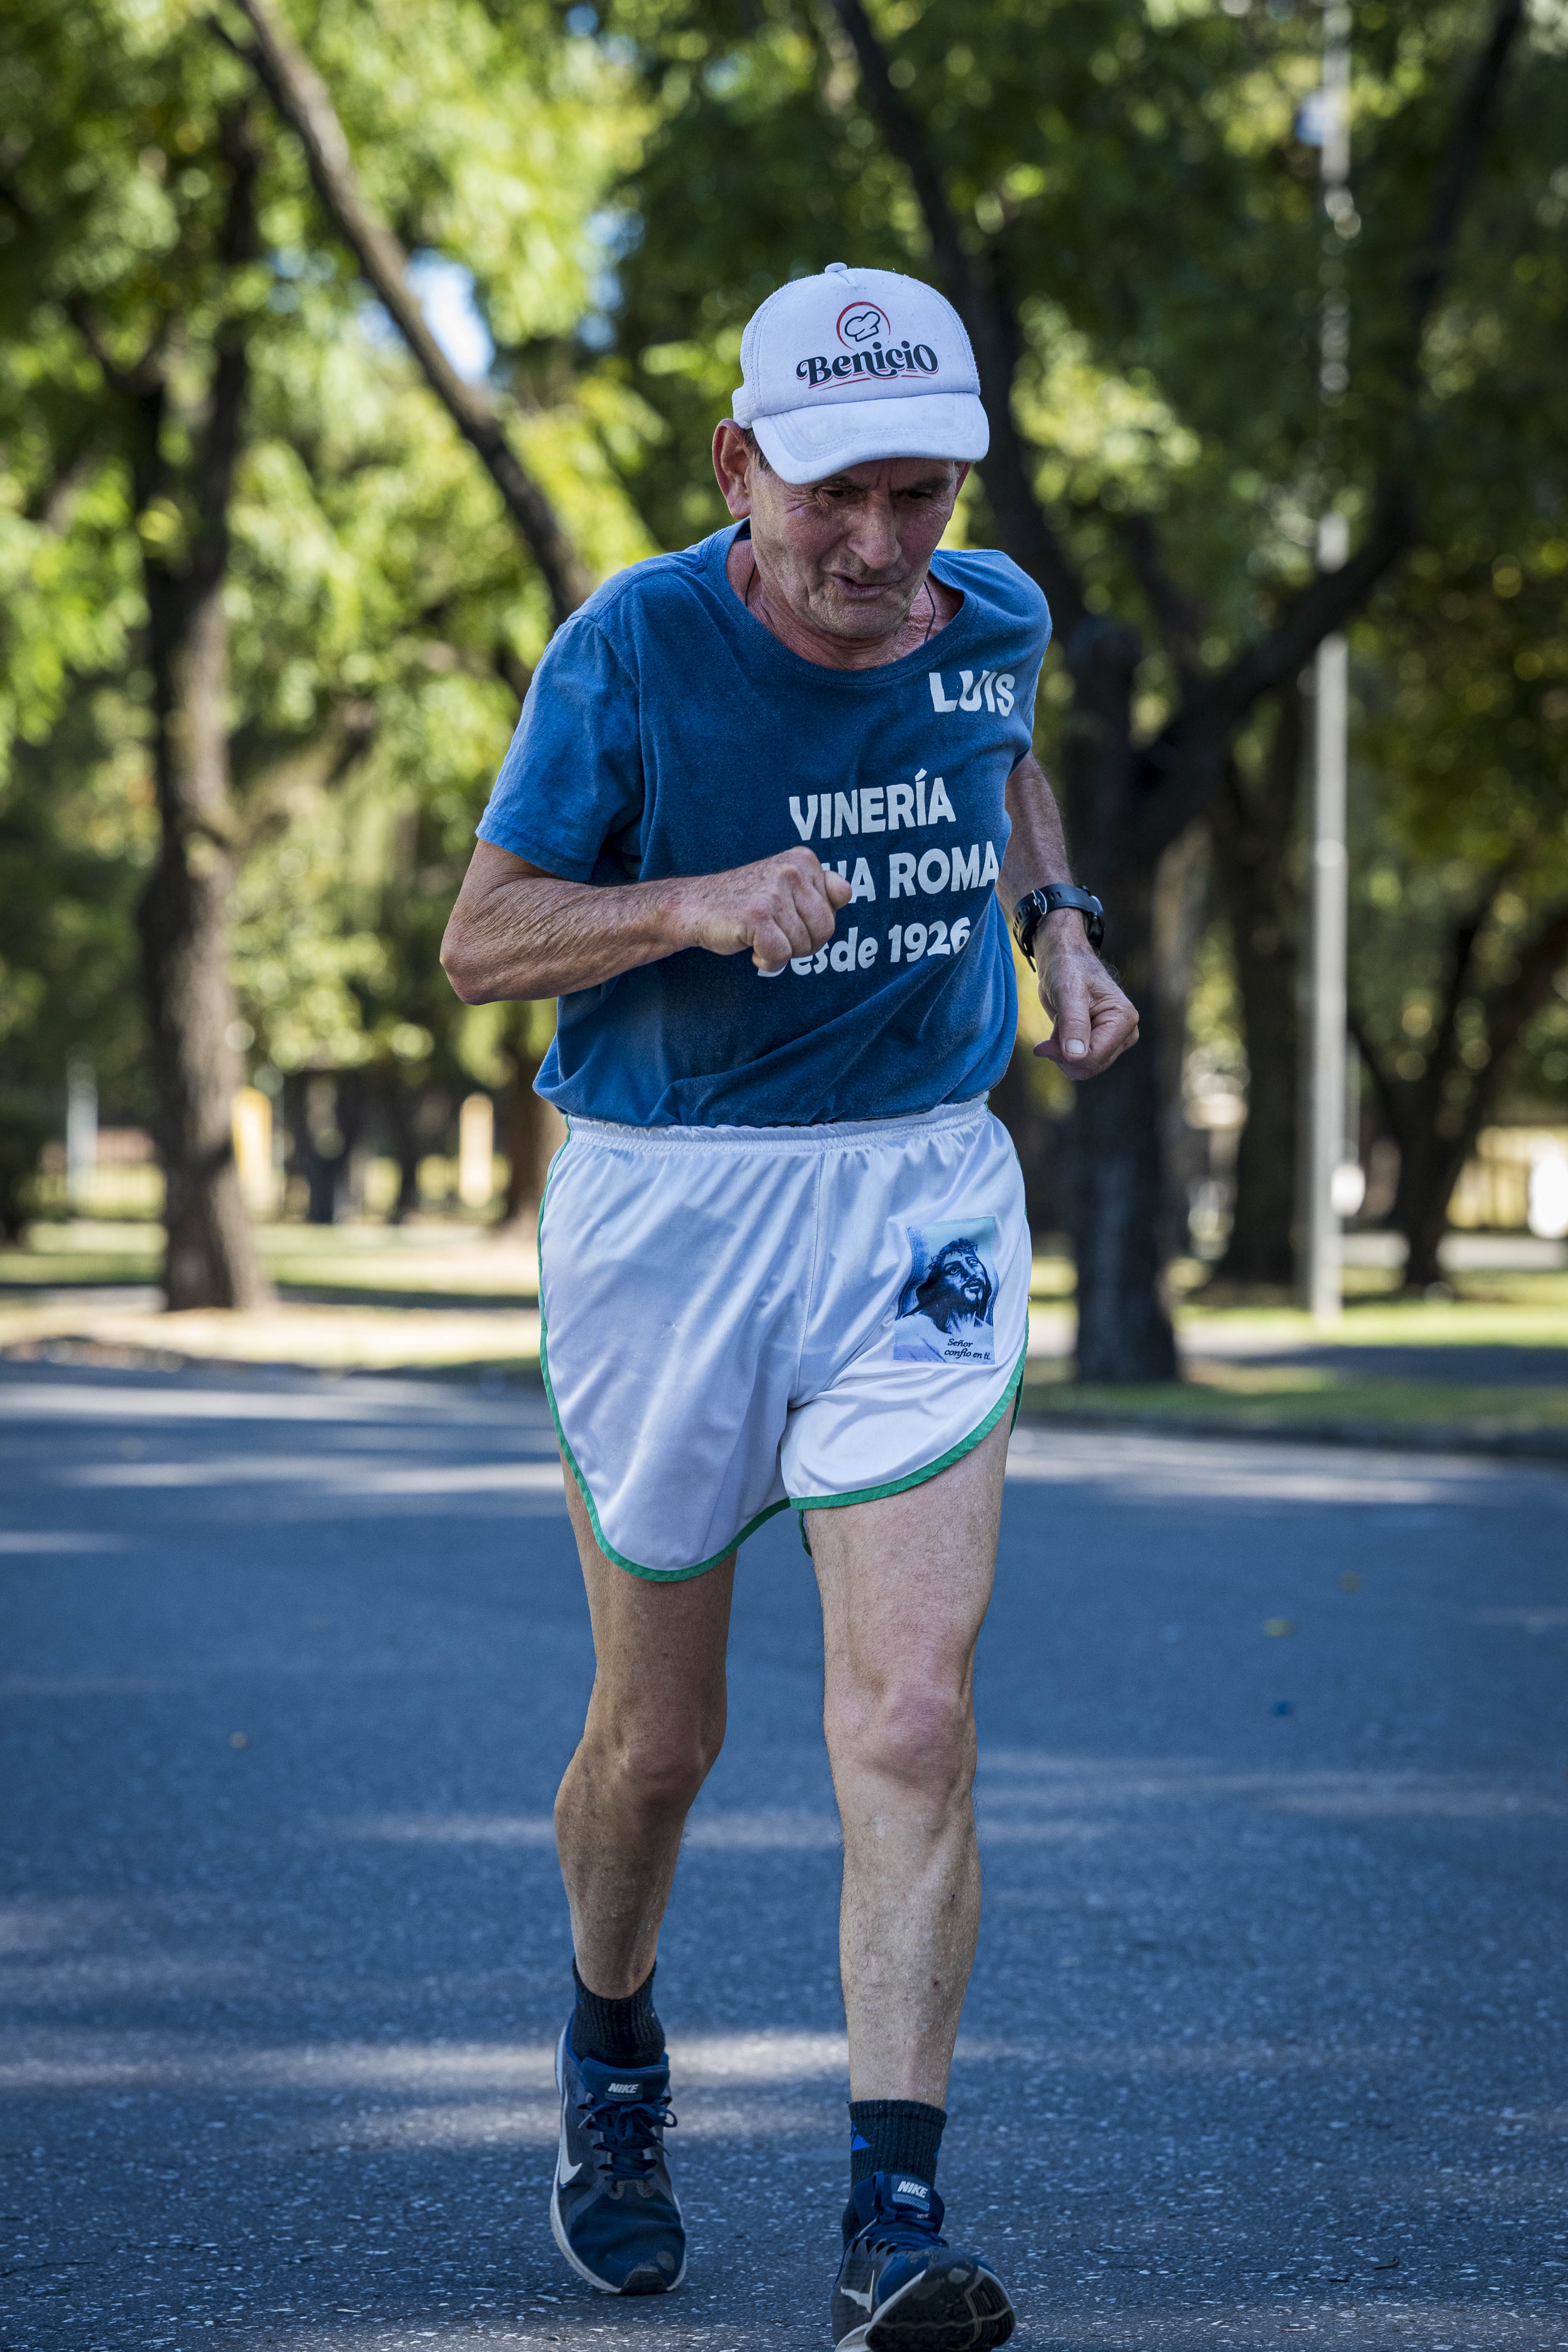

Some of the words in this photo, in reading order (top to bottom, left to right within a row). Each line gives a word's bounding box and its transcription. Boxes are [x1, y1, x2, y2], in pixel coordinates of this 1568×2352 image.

[929, 670, 1015, 717] LUIS
[789, 768, 956, 841] VINERÍA
[889, 841, 999, 899] ROMA
[757, 927, 878, 977] esde
[888, 917, 971, 963] 1926
[947, 1338, 973, 1347] Señor
[608, 2083, 639, 2093] NIKE
[897, 2180, 928, 2198] NIKE
